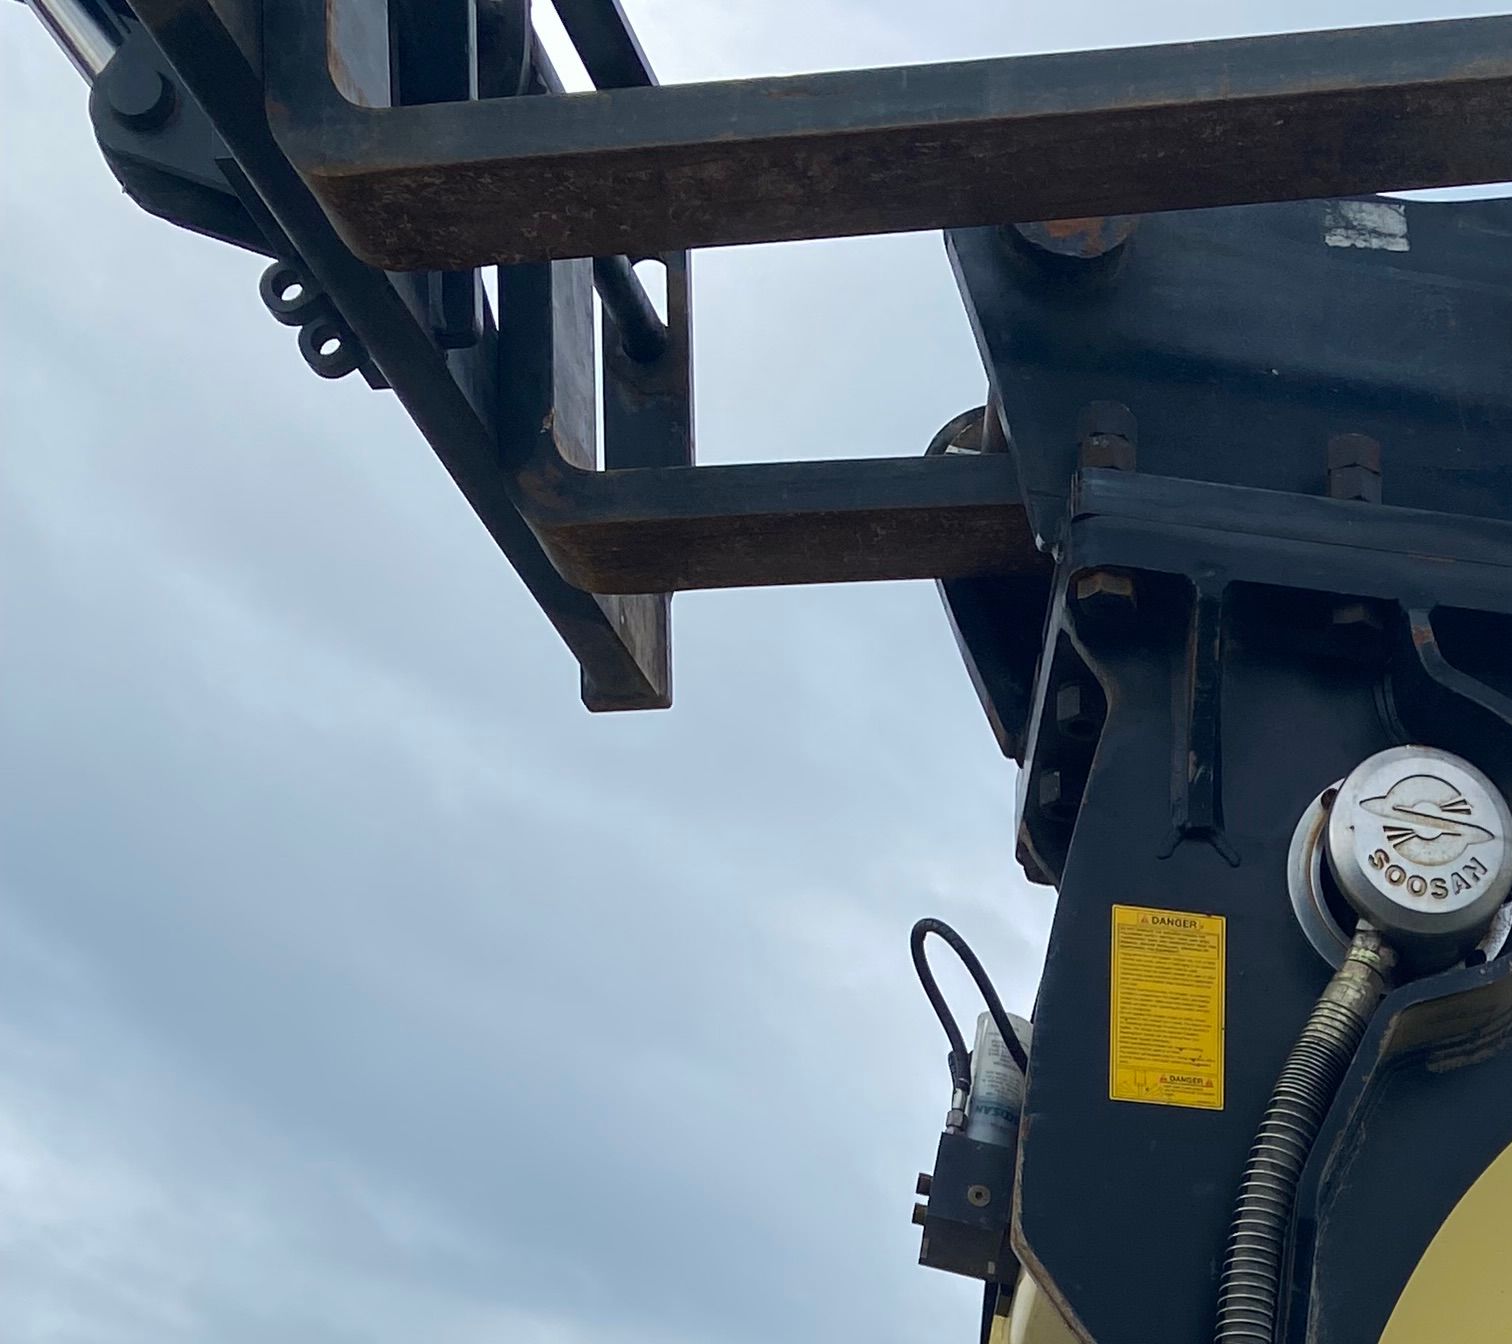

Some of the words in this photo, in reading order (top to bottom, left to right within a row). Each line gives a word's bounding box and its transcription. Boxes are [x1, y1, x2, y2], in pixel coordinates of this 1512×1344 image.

[1367, 848, 1488, 900] SOOSAN
[1151, 914, 1198, 930] DANGER
[1169, 1073, 1204, 1085] DANGER
